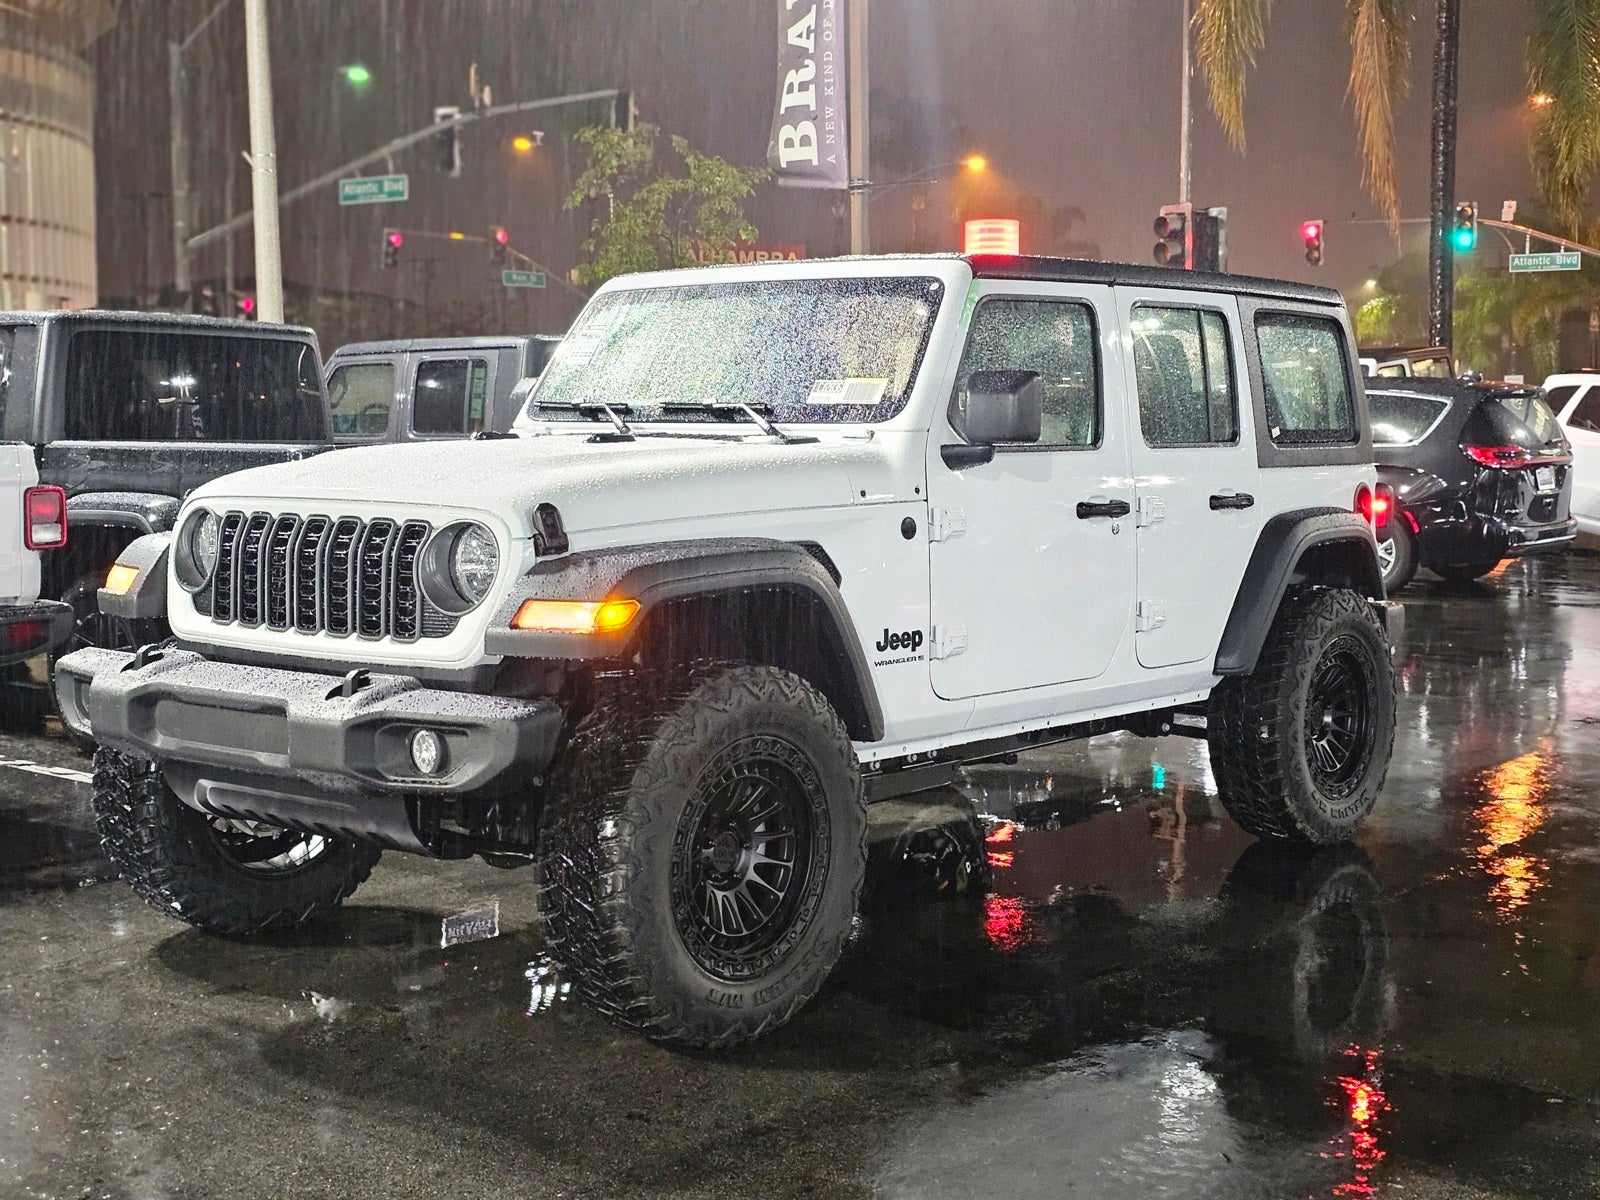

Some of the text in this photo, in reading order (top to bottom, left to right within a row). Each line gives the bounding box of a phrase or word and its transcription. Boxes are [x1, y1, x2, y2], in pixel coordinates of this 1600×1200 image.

[823, 19, 834, 41] OF
[779, 0, 819, 169] BRA
[823, 51, 834, 97] KIND
[825, 106, 836, 145] NEW
[827, 153, 837, 164] A
[1513, 256, 1551, 267] Atlantic
[1556, 255, 1577, 265] Blvd
[876, 628, 923, 652] Jeep
[874, 656, 917, 667] WRANGLER
